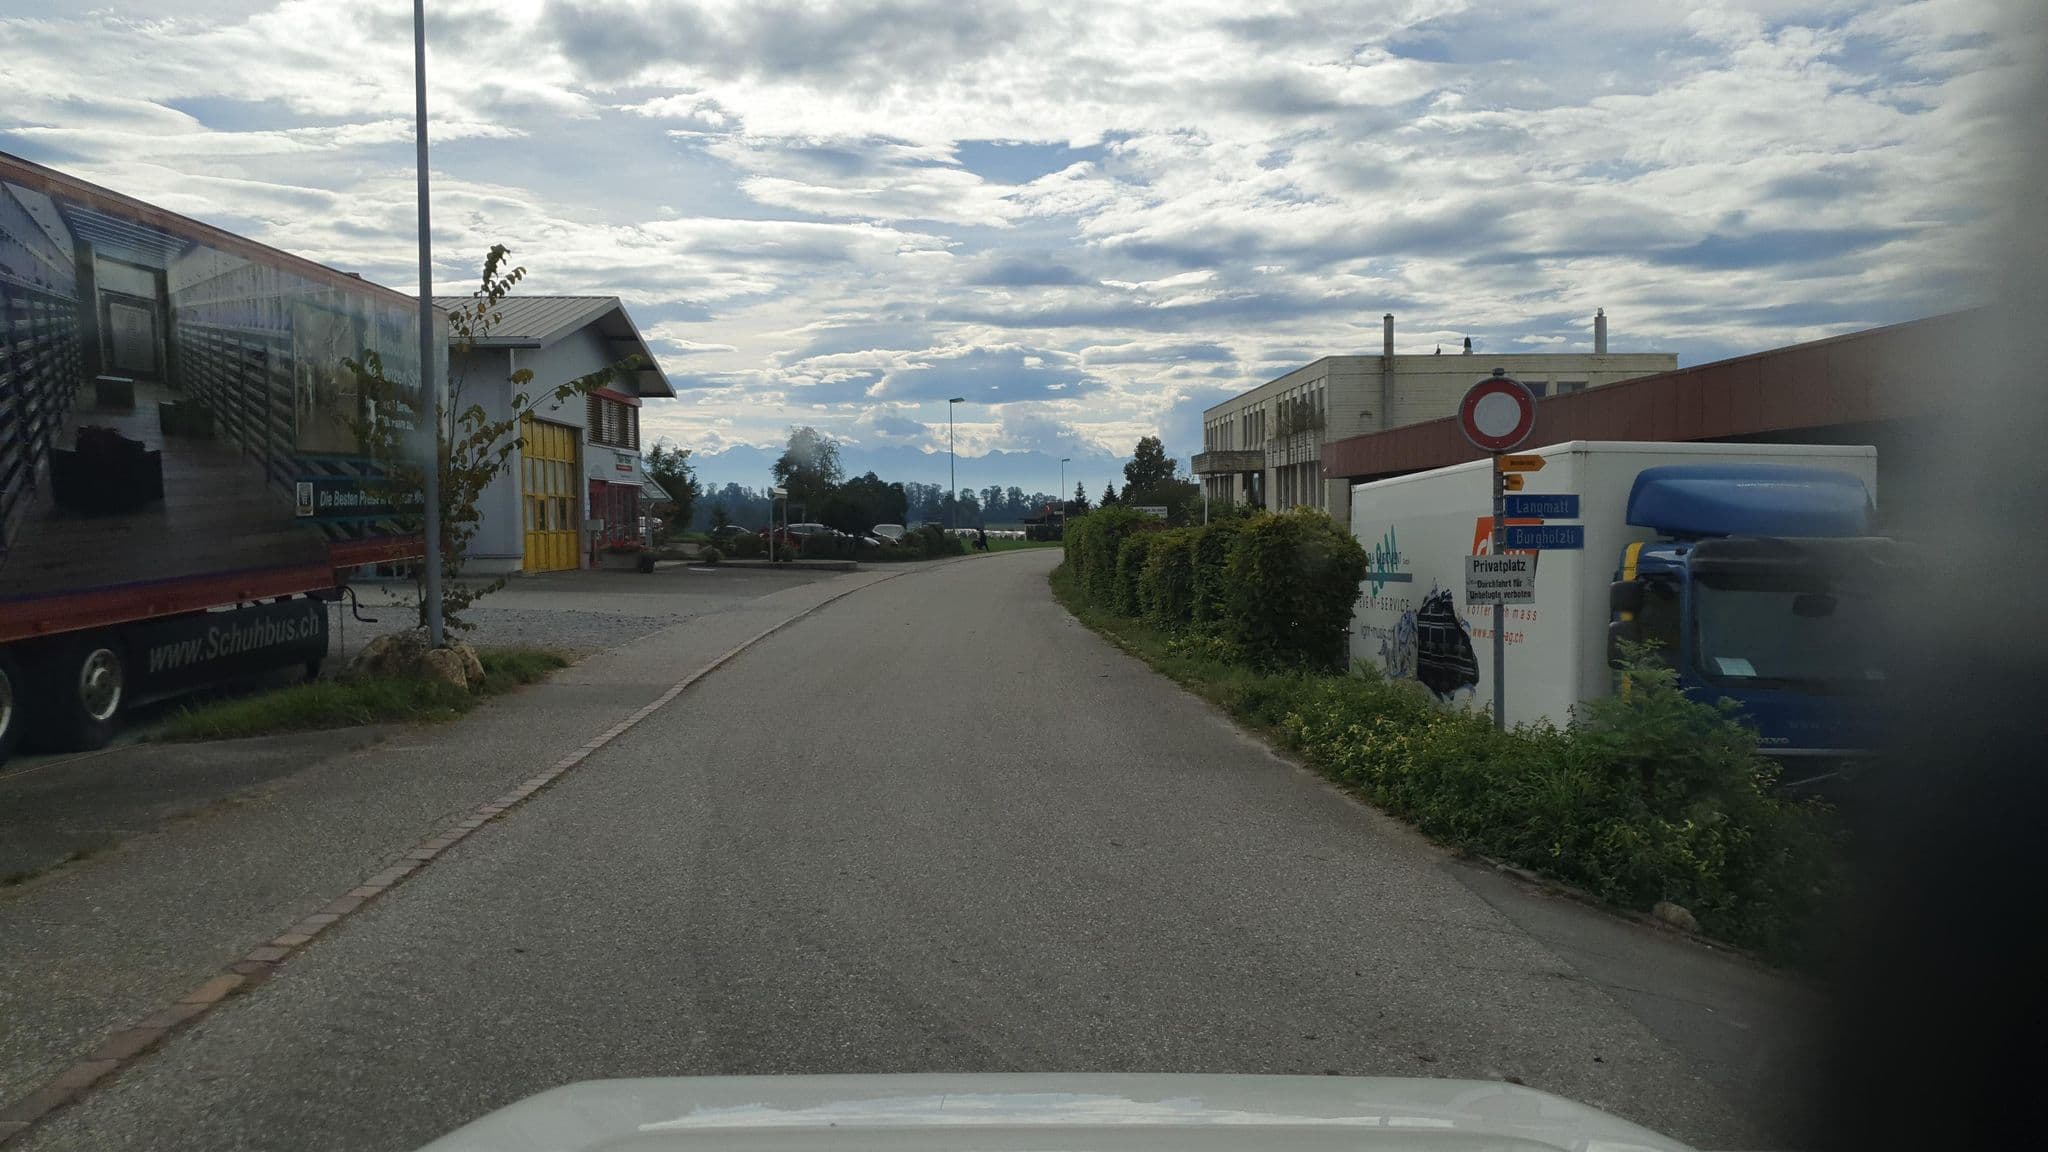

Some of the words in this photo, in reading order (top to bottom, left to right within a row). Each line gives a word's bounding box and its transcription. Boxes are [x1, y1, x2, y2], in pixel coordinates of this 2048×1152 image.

[320, 490, 333, 507] Die
[333, 490, 358, 507] Besten
[1516, 498, 1569, 518] Langmatt
[1473, 558, 1526, 574] Privatplatz
[1477, 578, 1512, 588] Durchfahrt
[1513, 578, 1523, 588] für
[1469, 590, 1502, 600] Unbefugte
[1503, 589, 1532, 599] verboten
[149, 606, 320, 673] www.Schuhbus.ch
